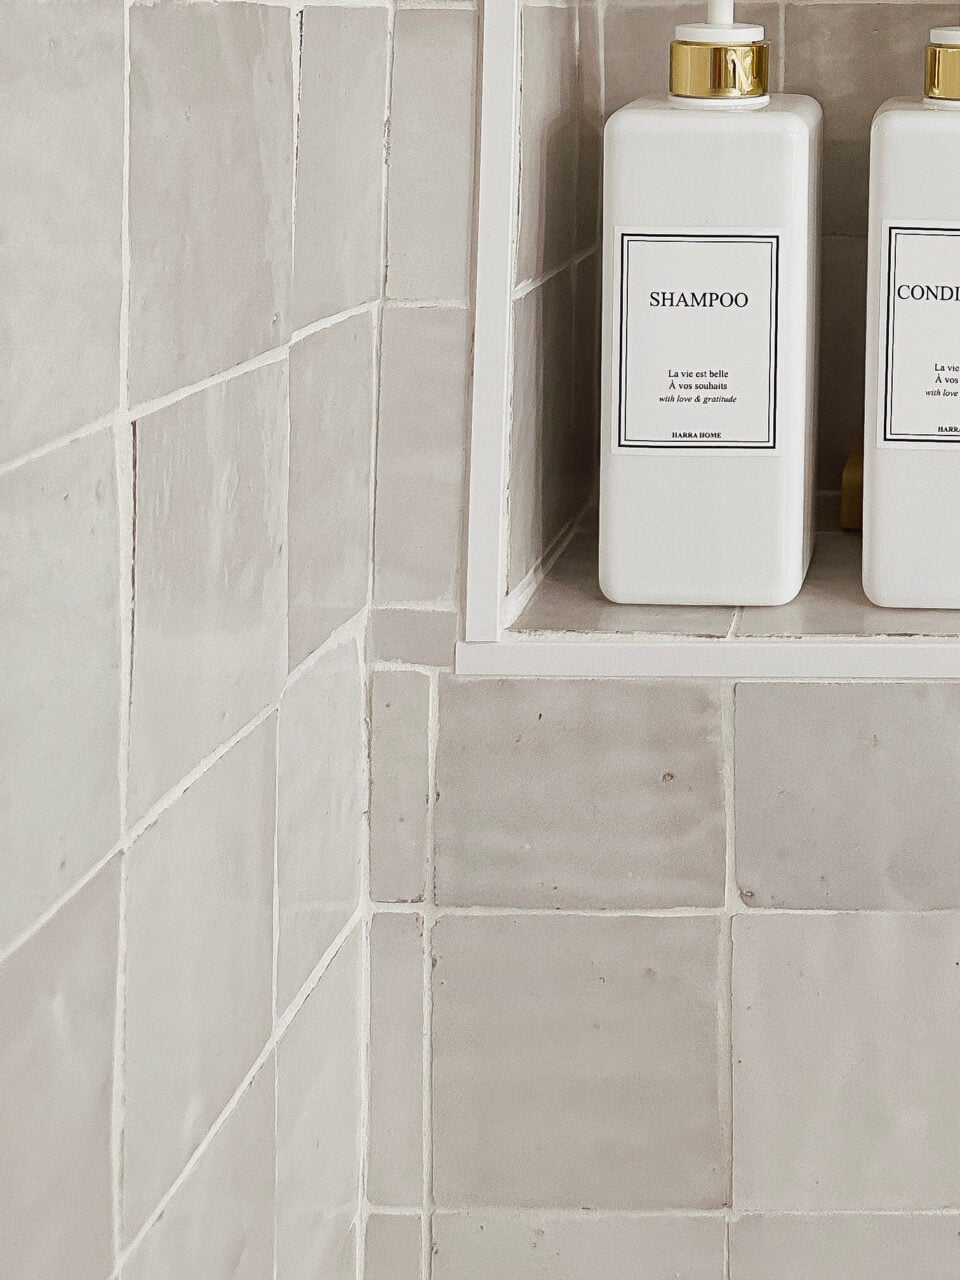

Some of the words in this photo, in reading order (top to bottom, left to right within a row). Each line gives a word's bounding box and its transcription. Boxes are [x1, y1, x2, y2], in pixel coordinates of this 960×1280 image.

[649, 291, 749, 308] SHAMPOO
[934, 363, 945, 372] La
[947, 364, 960, 372] vie
[668, 369, 679, 378] La
[680, 370, 694, 378] vie
[709, 369, 729, 378] belle
[934, 373, 942, 384] À
[668, 379, 677, 390] À
[678, 382, 693, 390] vos
[694, 381, 728, 390] souhaits
[925, 389, 941, 397] with
[942, 389, 958, 397] love
[659, 395, 675, 403] with
[676, 395, 692, 403] love
[694, 395, 701, 403] &
[702, 395, 737, 404] gratitude
[671, 431, 698, 439] HARRA
[699, 431, 722, 439] HOME
